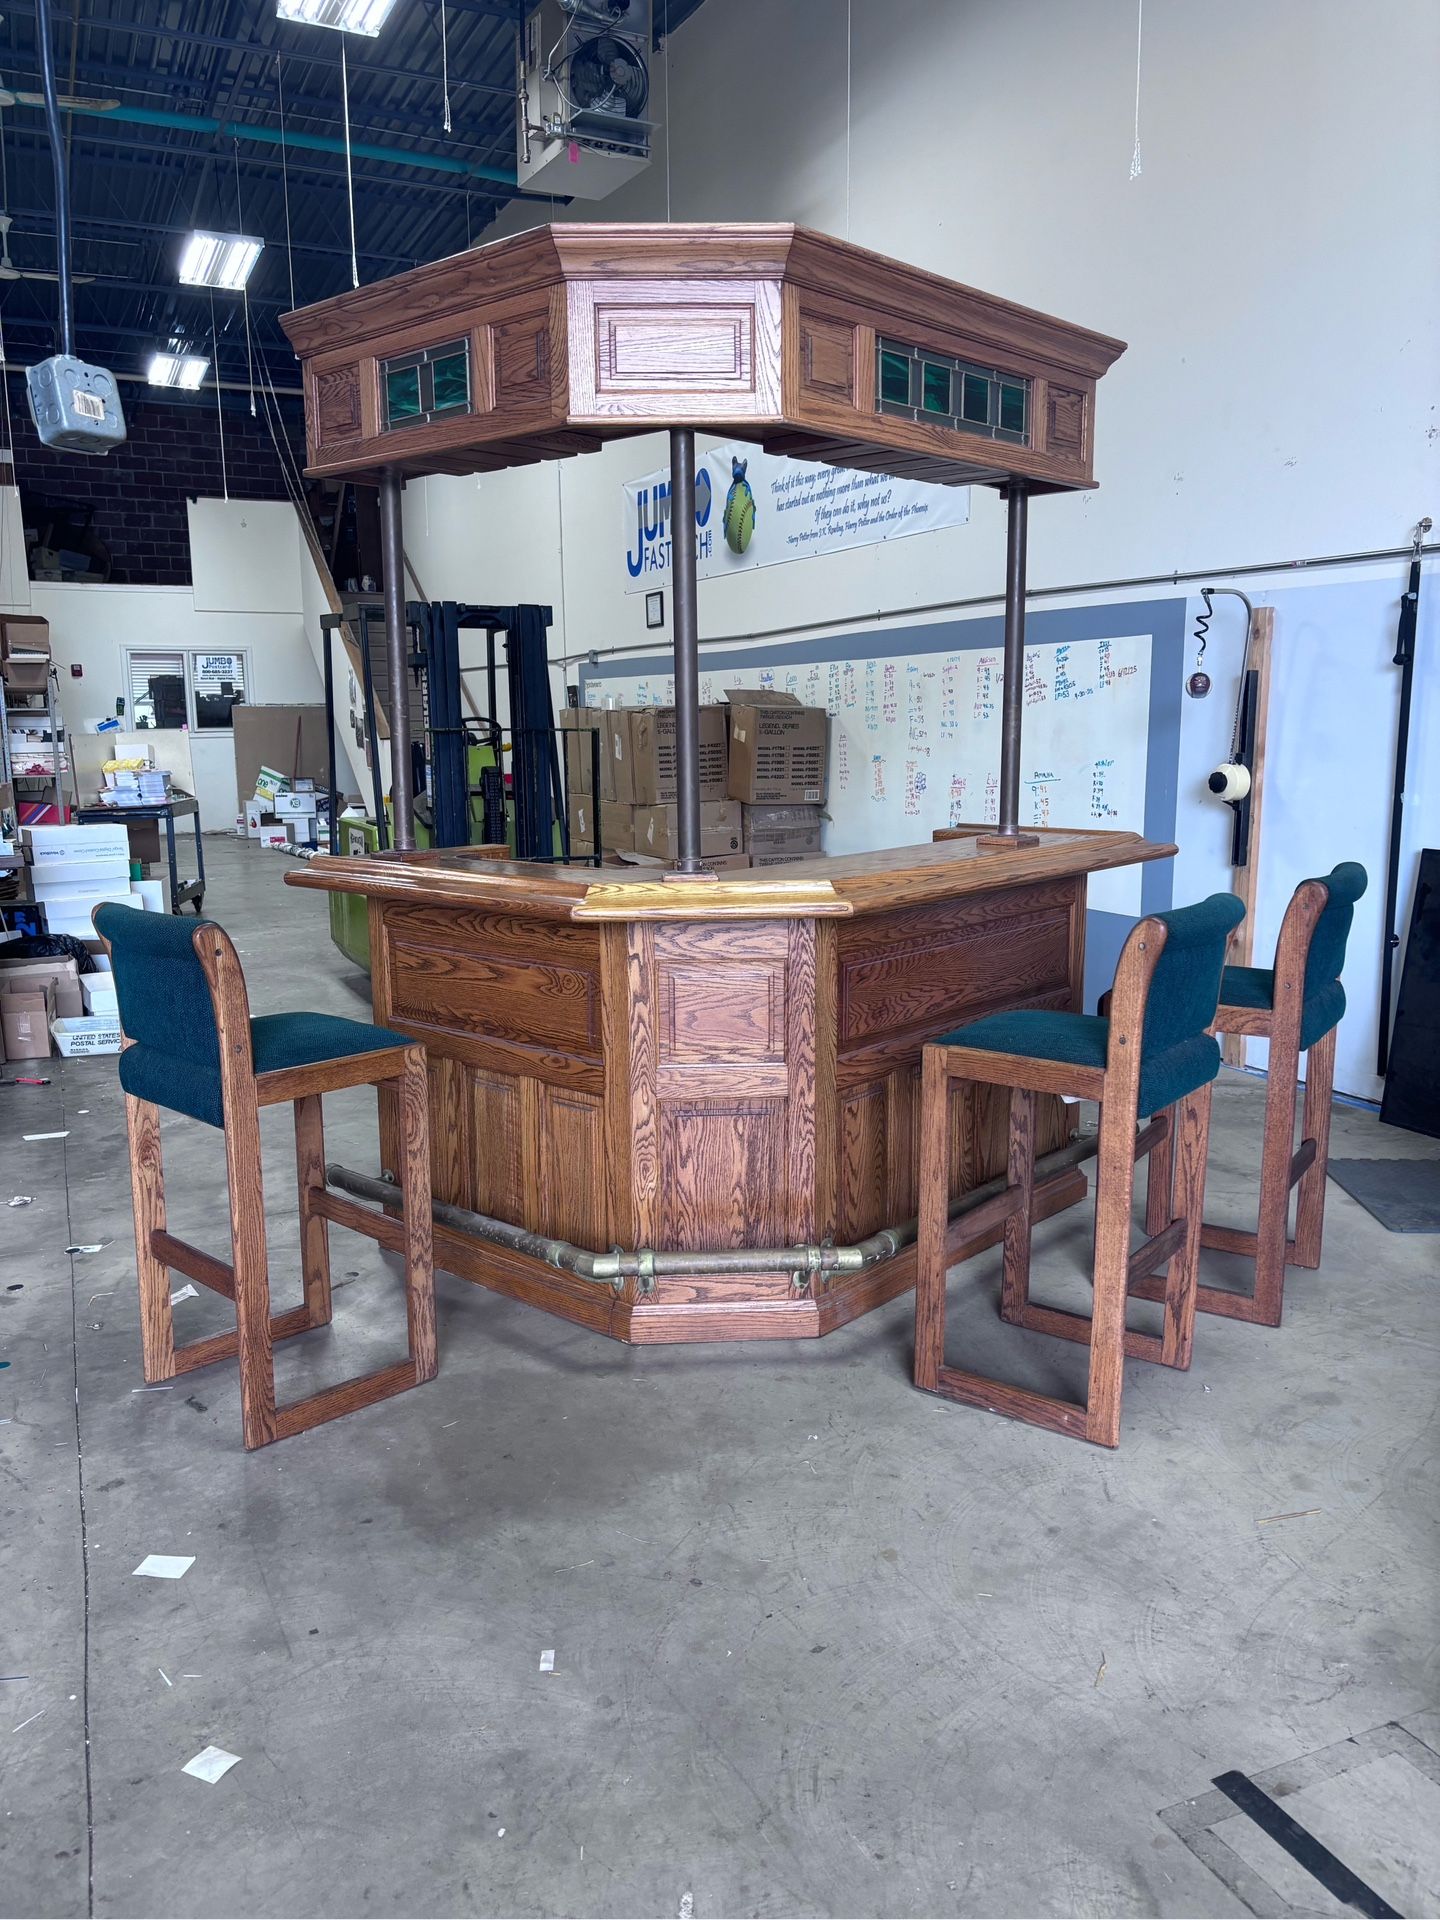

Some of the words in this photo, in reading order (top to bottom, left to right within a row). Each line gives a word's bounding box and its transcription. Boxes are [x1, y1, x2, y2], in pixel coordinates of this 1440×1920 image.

[776, 498, 785, 511] has
[785, 491, 801, 510] started
[801, 492, 810, 505] out
[816, 487, 835, 504] nothing
[836, 484, 850, 495] more
[850, 474, 863, 491] than
[864, 473, 879, 487] what
[796, 472, 804, 486] this
[821, 505, 832, 525] they
[833, 508, 841, 516] can
[842, 498, 850, 514] do
[857, 494, 869, 516] why
[870, 493, 881, 506] not
[881, 489, 892, 505] us?
[845, 522, 857, 533] Harry
[858, 518, 870, 527] Potter
[870, 512, 878, 524] and
[897, 506, 903, 520] of
[627, 468, 711, 577] JUMO
[202, 657, 232, 669] JUMBO
[257, 778, 269, 788] one
